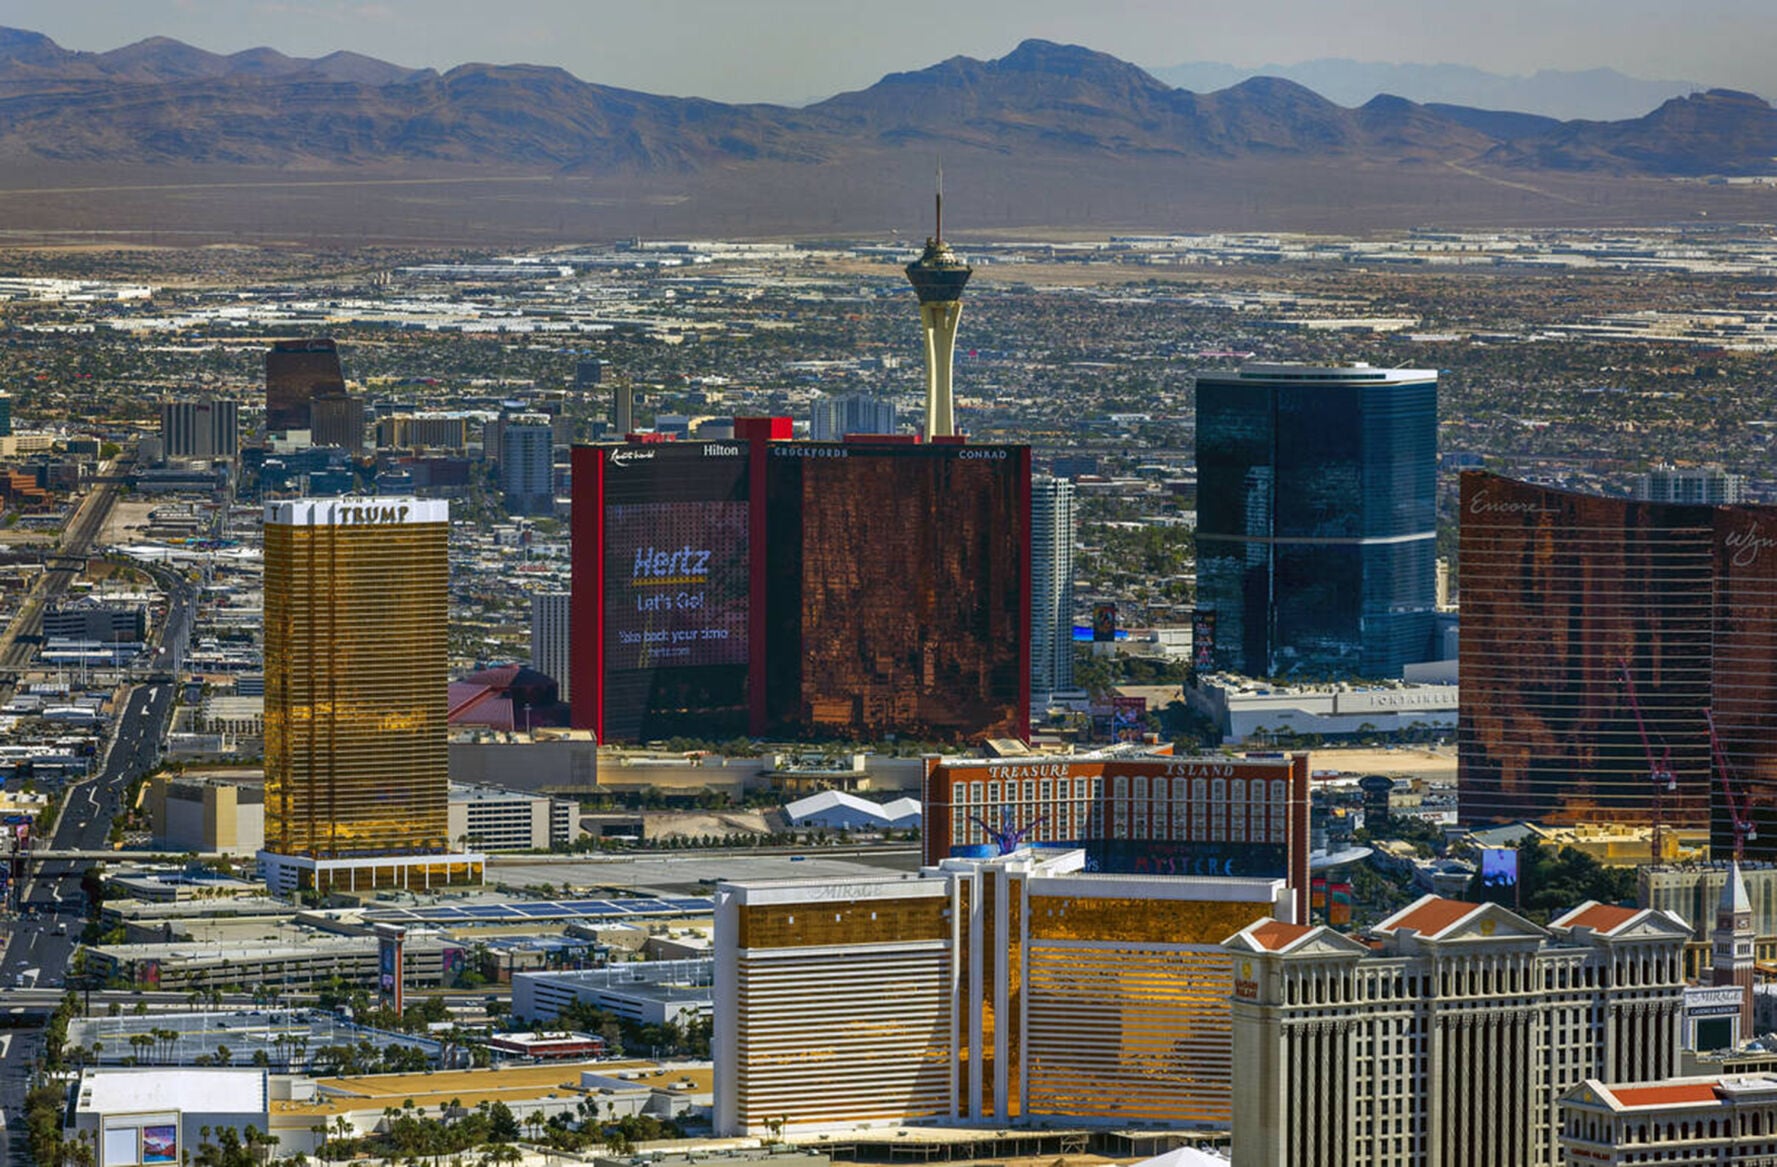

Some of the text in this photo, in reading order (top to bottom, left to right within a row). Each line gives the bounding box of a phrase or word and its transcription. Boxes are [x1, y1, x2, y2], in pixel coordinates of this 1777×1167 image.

[703, 444, 738, 456] Hilton
[774, 447, 848, 458] CROCKFORDS
[959, 450, 1007, 459] CONRAD
[1470, 489, 1561, 514] Encore
[339, 506, 410, 522] TRUMP
[1725, 521, 1777, 566] Wyn
[633, 545, 711, 577] Hertz
[637, 591, 704, 611] Let's Go!
[988, 764, 1235, 779] TREASURE ISLAND
